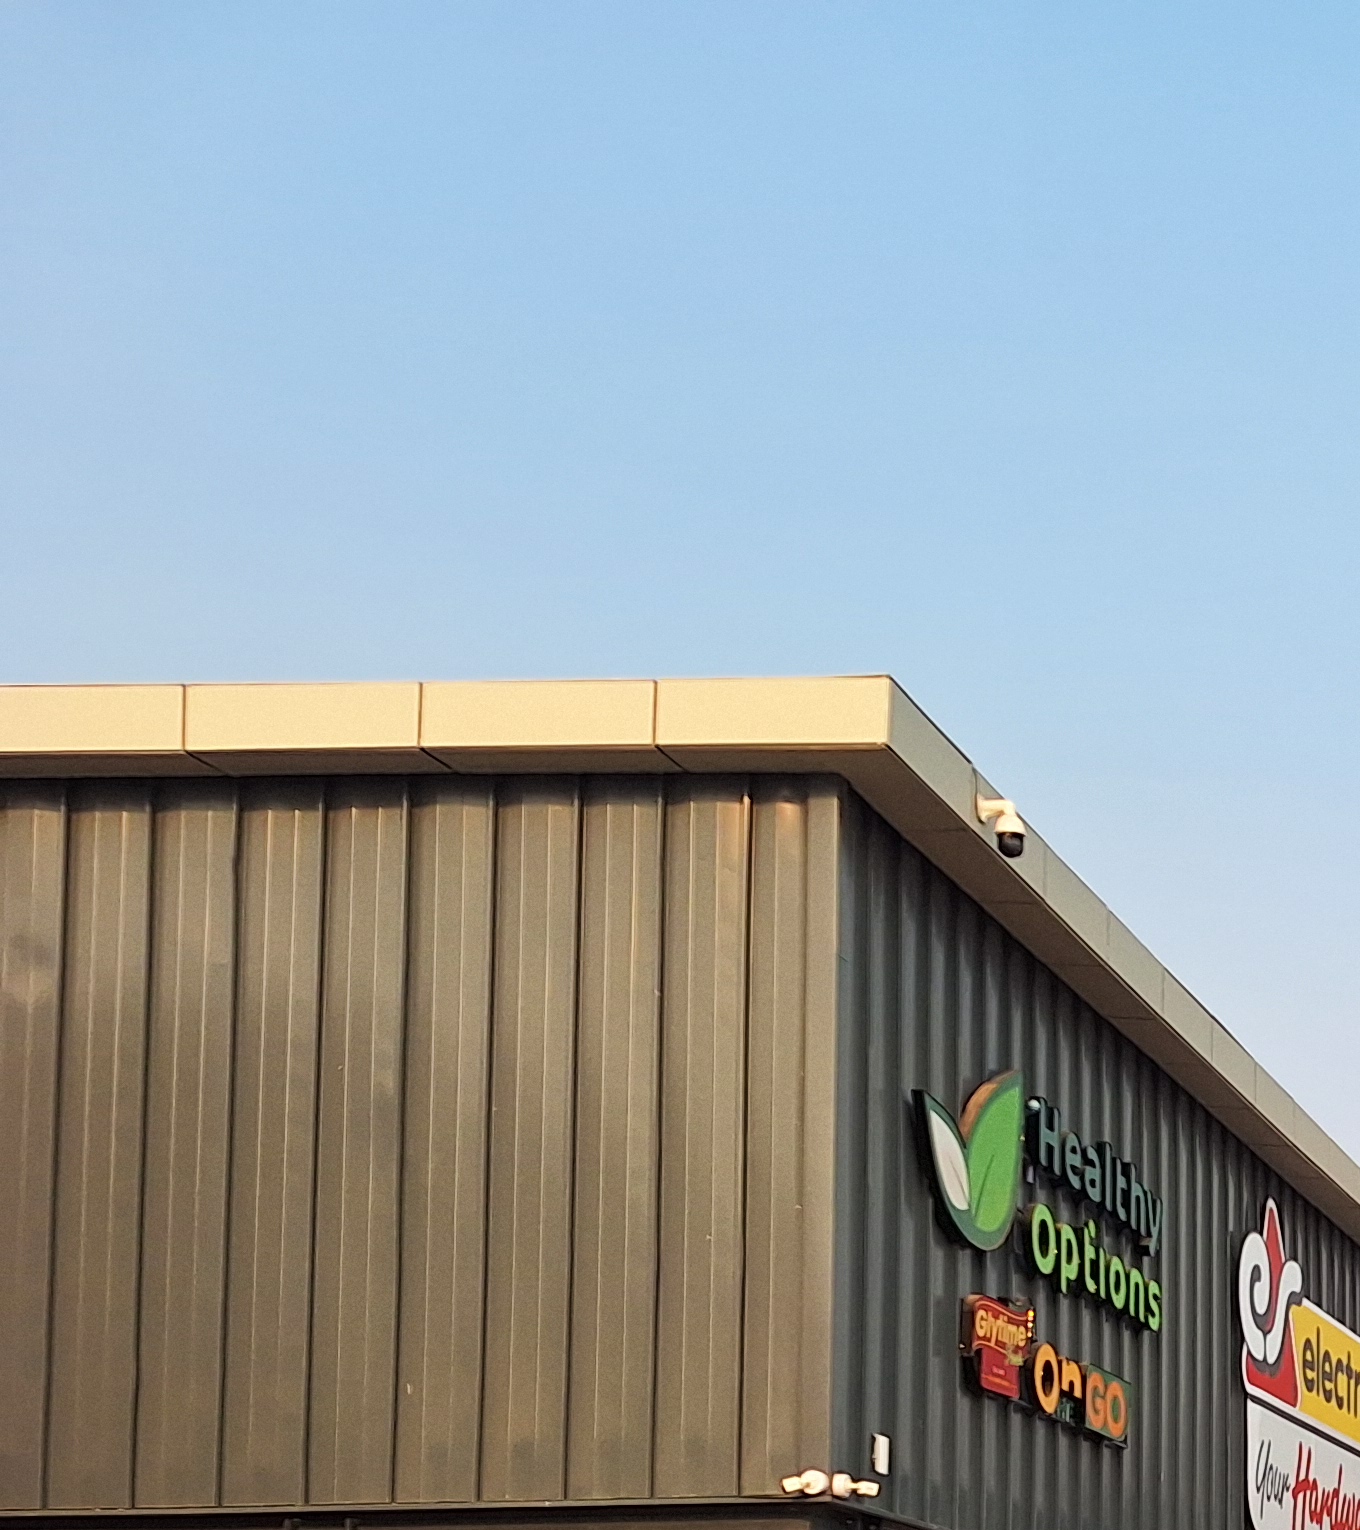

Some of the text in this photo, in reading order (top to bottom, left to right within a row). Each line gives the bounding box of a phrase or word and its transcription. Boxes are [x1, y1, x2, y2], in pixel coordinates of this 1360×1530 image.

[1038, 1096, 1163, 1258] Healthy
[1031, 1203, 1162, 1332] Options
[1086, 1372, 1128, 1438] GO
[1255, 1439, 1292, 1521] Your
